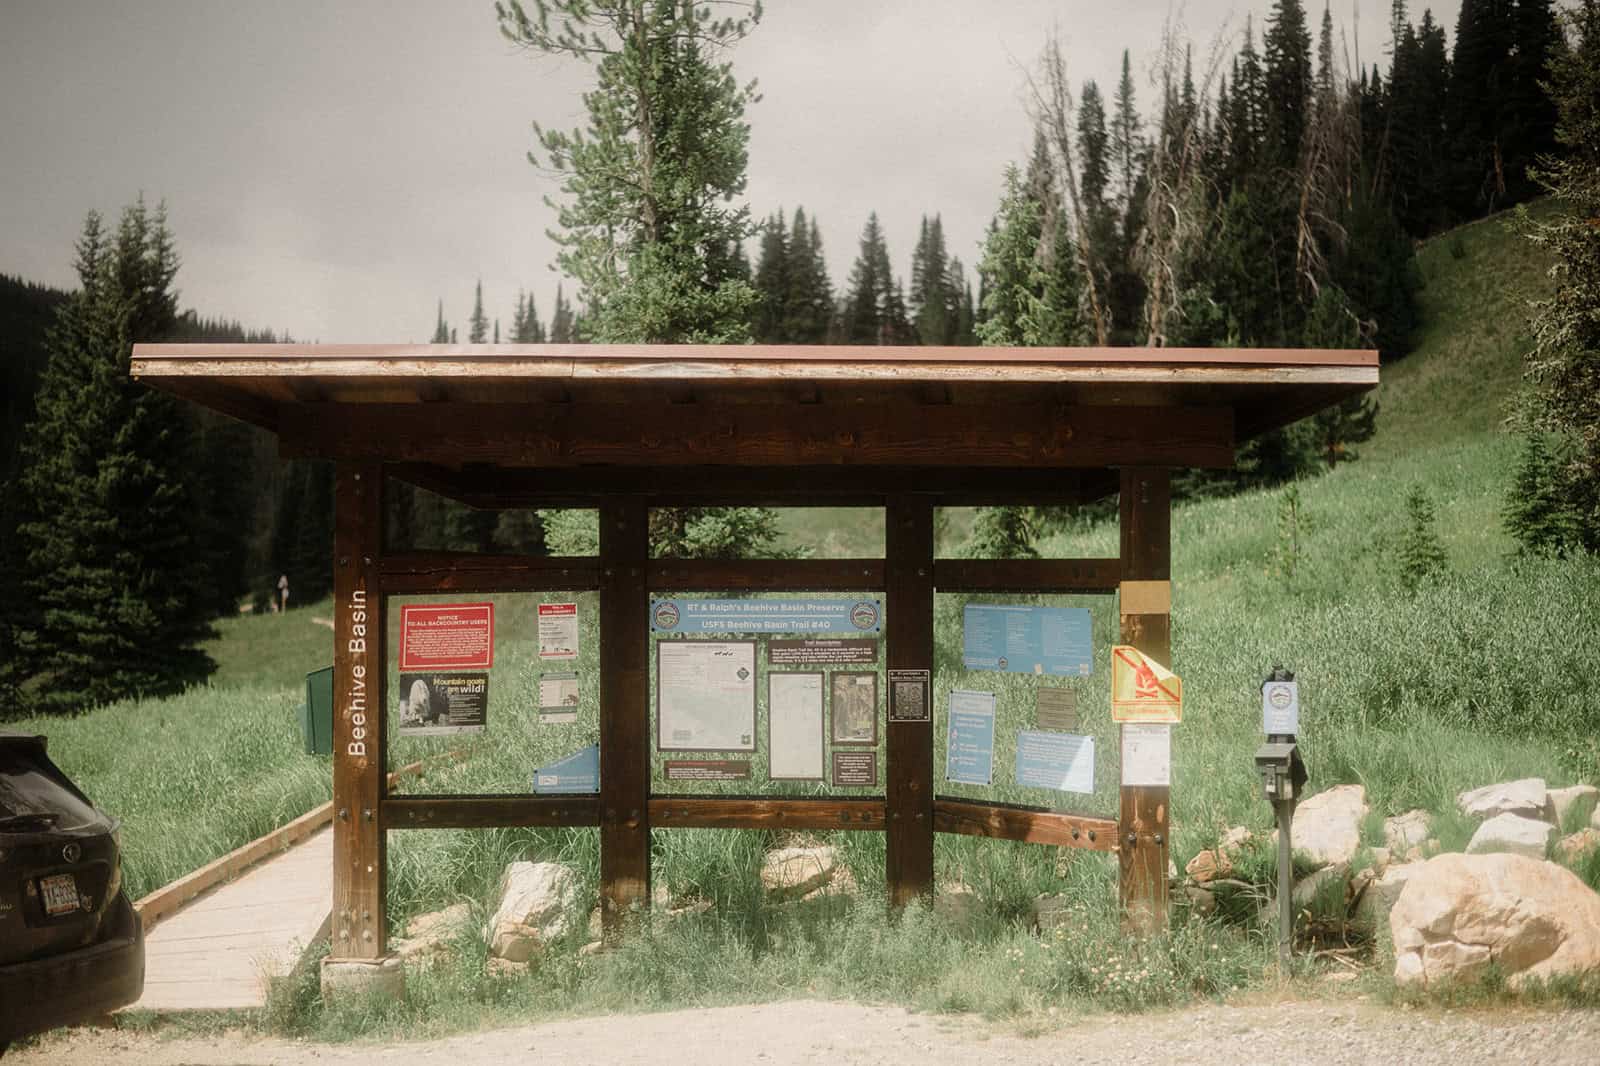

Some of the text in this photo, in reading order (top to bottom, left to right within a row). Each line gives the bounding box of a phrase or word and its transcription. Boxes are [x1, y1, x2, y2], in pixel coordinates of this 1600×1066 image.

[709, 604, 742, 613] Ralph's
[764, 621, 788, 629] Basin
[348, 590, 366, 756] Beehive Basin
[433, 678, 465, 686] Mountain
[460, 684, 484, 694] wild!
